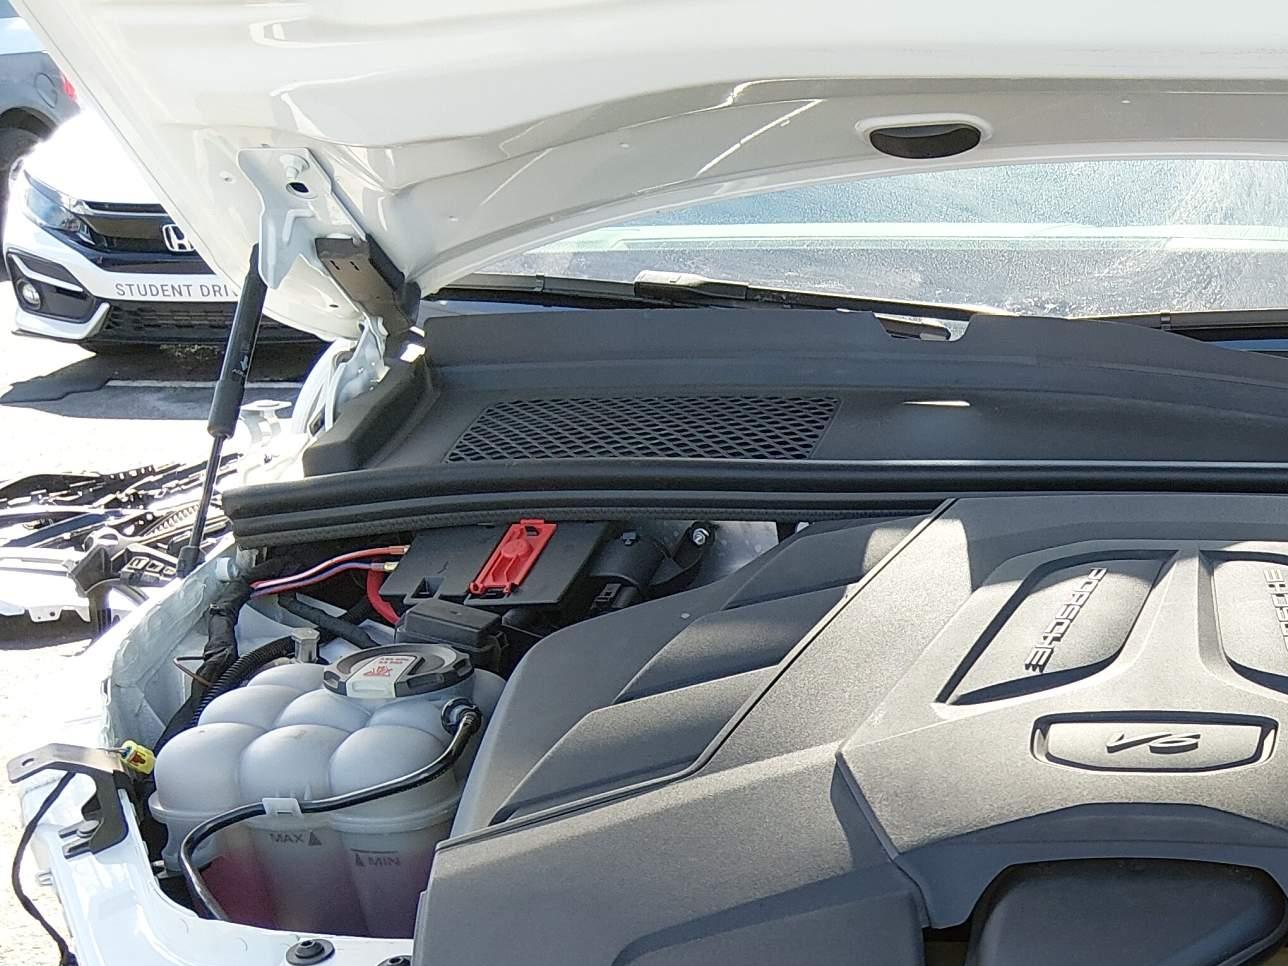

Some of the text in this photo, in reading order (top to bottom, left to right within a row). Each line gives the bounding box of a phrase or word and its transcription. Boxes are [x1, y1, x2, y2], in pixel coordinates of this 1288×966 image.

[115, 283, 192, 297] STUDENT
[1025, 567, 1108, 673] PORSCHE
[1106, 731, 1201, 754] V6
[270, 833, 304, 844] MAX
[367, 856, 401, 867] MIN
